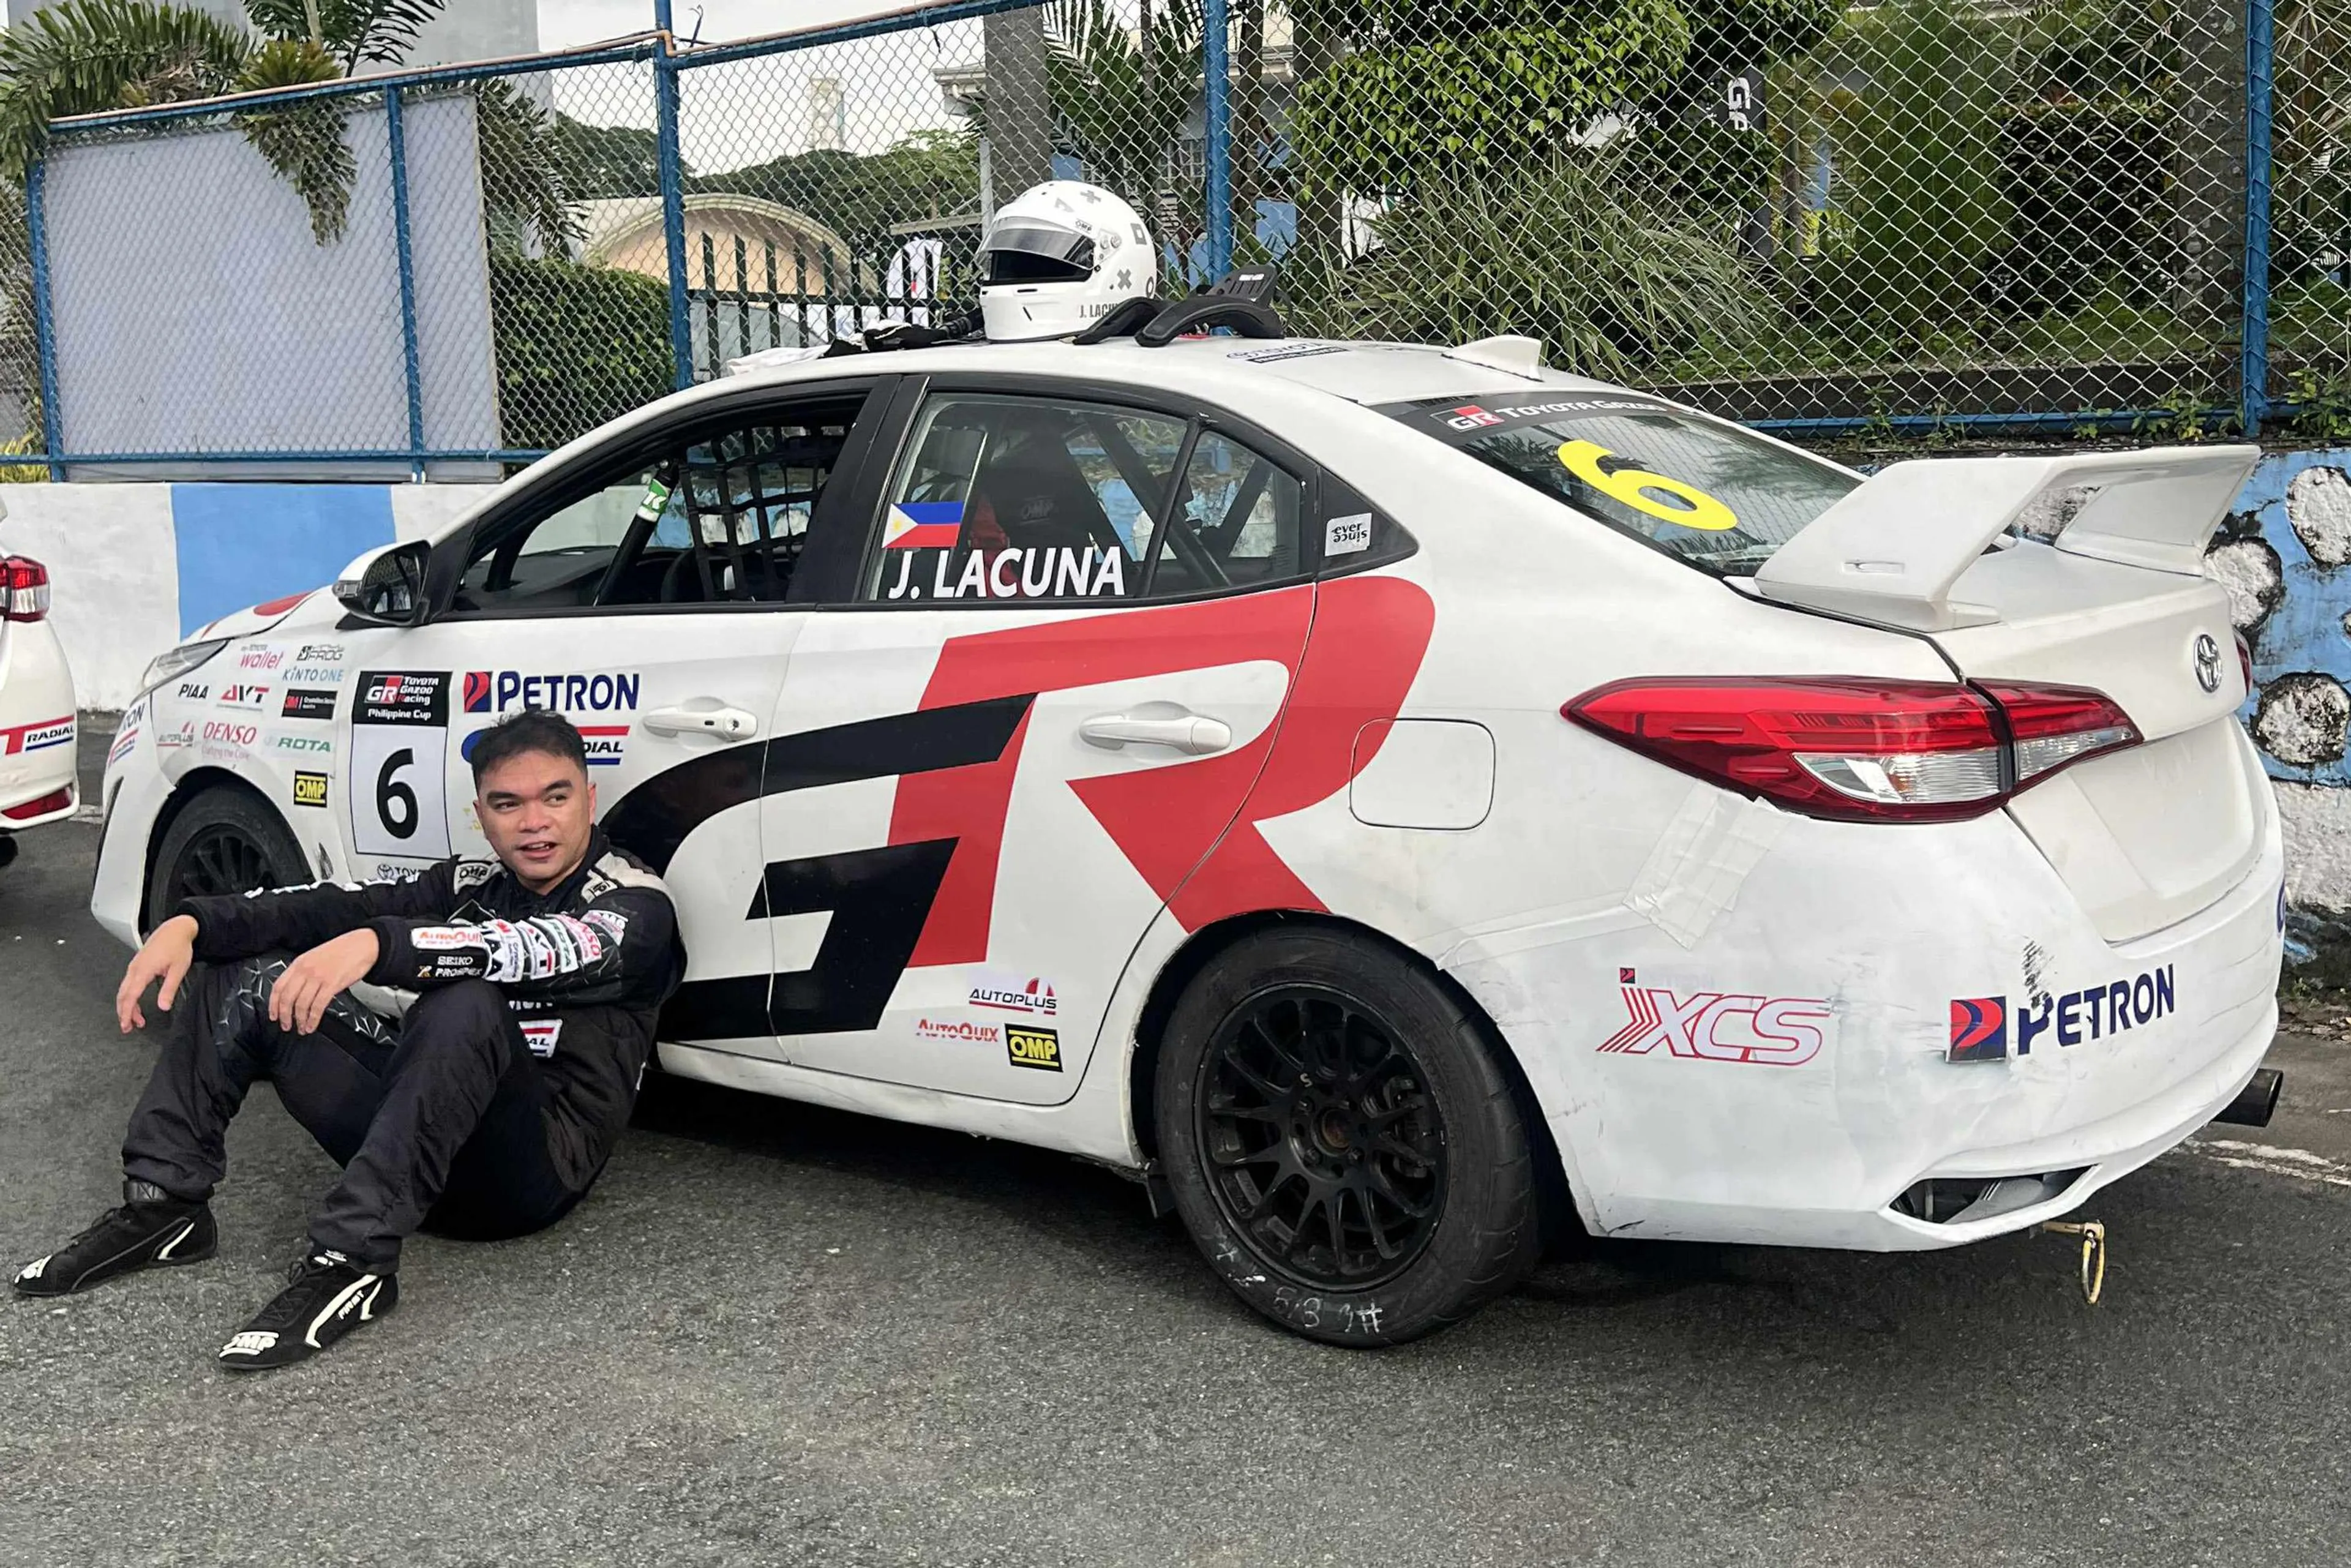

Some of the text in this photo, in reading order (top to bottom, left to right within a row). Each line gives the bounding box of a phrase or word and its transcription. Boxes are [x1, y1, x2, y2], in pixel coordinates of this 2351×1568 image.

[1447, 412, 1500, 430] GR
[1495, 400, 1590, 419] TOYOTA
[1557, 439, 1738, 531] 6
[1332, 522, 1363, 535] ever
[888, 546, 1125, 599] J. LACUNA
[240, 651, 284, 669] wallet
[319, 669, 344, 682] ONE
[404, 676, 440, 686] TOYOTA
[178, 683, 209, 699] PIAA
[367, 686, 398, 702] GR
[397, 693, 430, 705] Racing
[497, 671, 639, 712] PETRON
[368, 708, 432, 721] Philippine Cup
[27, 724, 74, 743] RADIAL
[204, 721, 257, 745] DENSO
[277, 737, 331, 752] ROTA
[582, 741, 623, 753] DIAL
[295, 779, 326, 799] OMP
[376, 748, 419, 840] 6
[459, 867, 487, 878] OMP
[437, 956, 474, 966] SEIKO
[970, 988, 1057, 1010] AUTOPLUS
[2017, 963, 2175, 1056] PETRON
[1010, 1035, 1057, 1060] OMP
